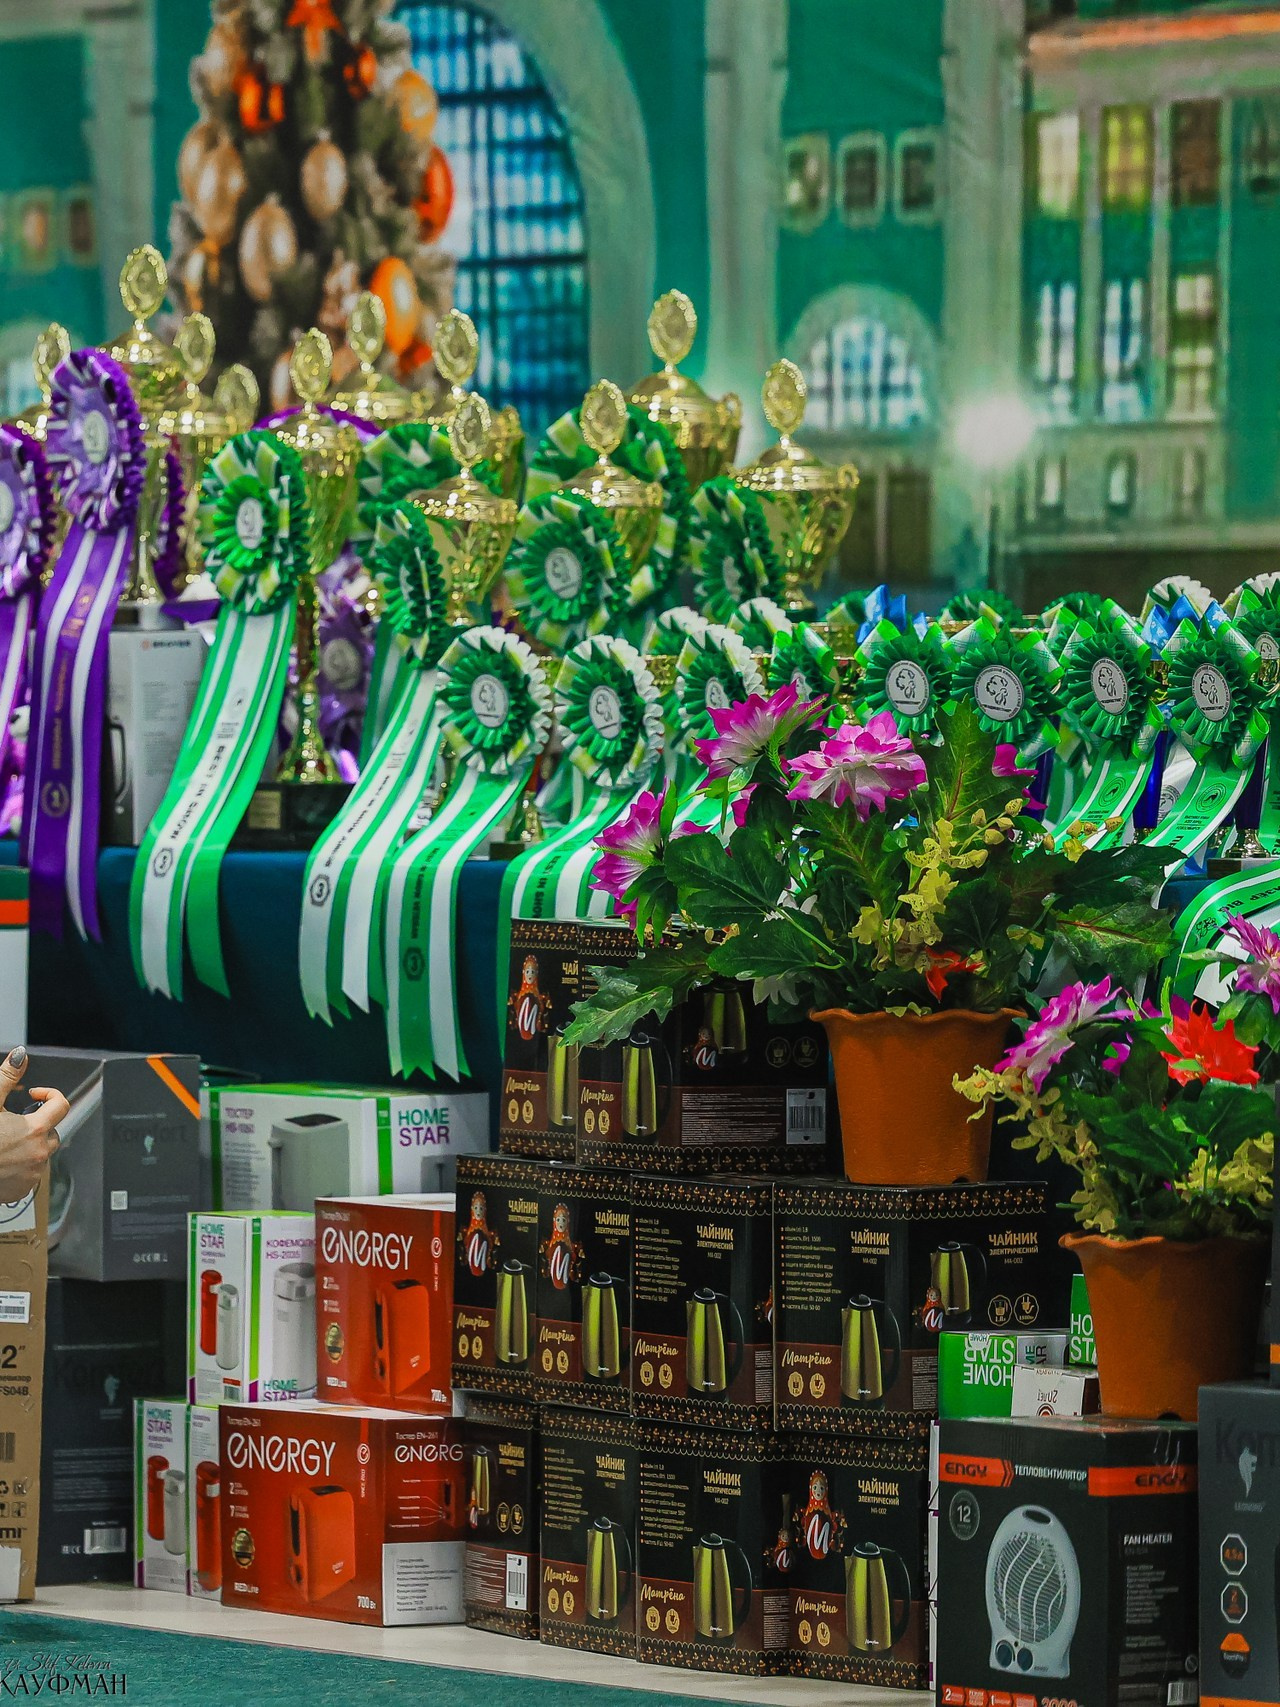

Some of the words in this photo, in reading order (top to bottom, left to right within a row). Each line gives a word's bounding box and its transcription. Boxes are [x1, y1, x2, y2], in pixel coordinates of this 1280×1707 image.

[398, 1107, 450, 1126] HOME
[399, 1126, 450, 1147] STAR
[595, 1209, 630, 1227] ЧАЙНИК
[201, 1223, 225, 1236] HOME
[696, 1223, 734, 1241] ЧАЙНИК
[850, 1228, 890, 1246] ЧАЙНИК
[988, 1230, 1038, 1246] ЧАЙНИК
[201, 1235, 225, 1249] STAR
[539, 1326, 576, 1345] Матрёна
[634, 1338, 679, 1358] Матрёна
[781, 1348, 833, 1369] Матрёна
[963, 1363, 1014, 1387] HOME
[263, 1379, 297, 1390] HOME
[147, 1409, 172, 1420] HOME
[147, 1419, 173, 1433] STAR
[595, 1453, 626, 1472] ЧАЙНИК
[703, 1468, 741, 1487] ЧАЙНИК
[1014, 1464, 1088, 1482] ТЕПЛОВЕНТИЛЯТОР
[857, 1478, 900, 1497] ЧАЙНИК
[857, 1495, 900, 1506] ЭЛЕКТРИЧЕСКИЙ
[957, 1505, 971, 1522] 12
[1123, 1534, 1141, 1546] FAN
[1142, 1533, 1173, 1545] HEATER
[543, 1566, 580, 1585] Матрёна
[640, 1583, 686, 1604] Матрёна
[795, 1596, 839, 1617] Матрёна
